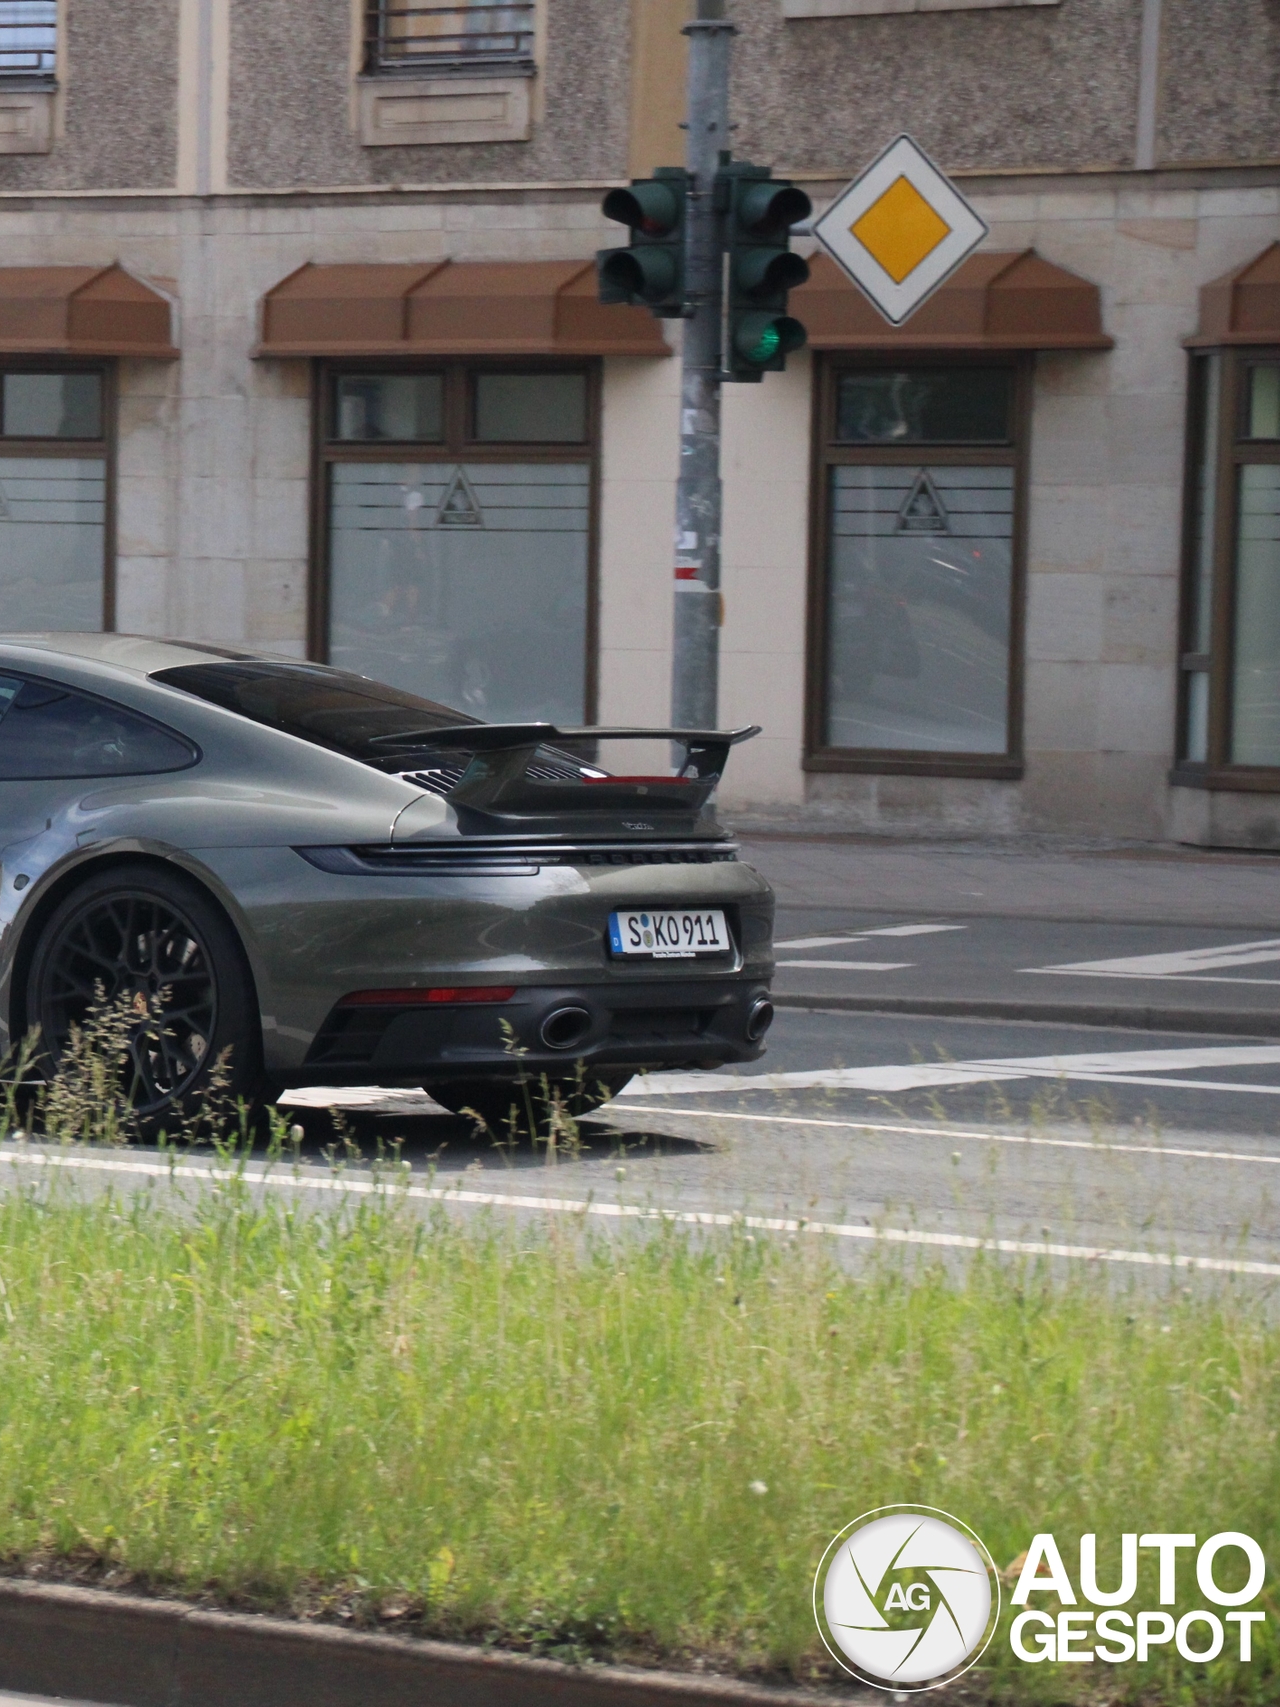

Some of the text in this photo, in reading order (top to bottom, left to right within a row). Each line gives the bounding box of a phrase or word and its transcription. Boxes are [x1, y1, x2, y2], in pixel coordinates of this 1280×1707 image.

[628, 916, 642, 947] S
[682, 914, 720, 946] 911
[613, 937, 619, 947] D
